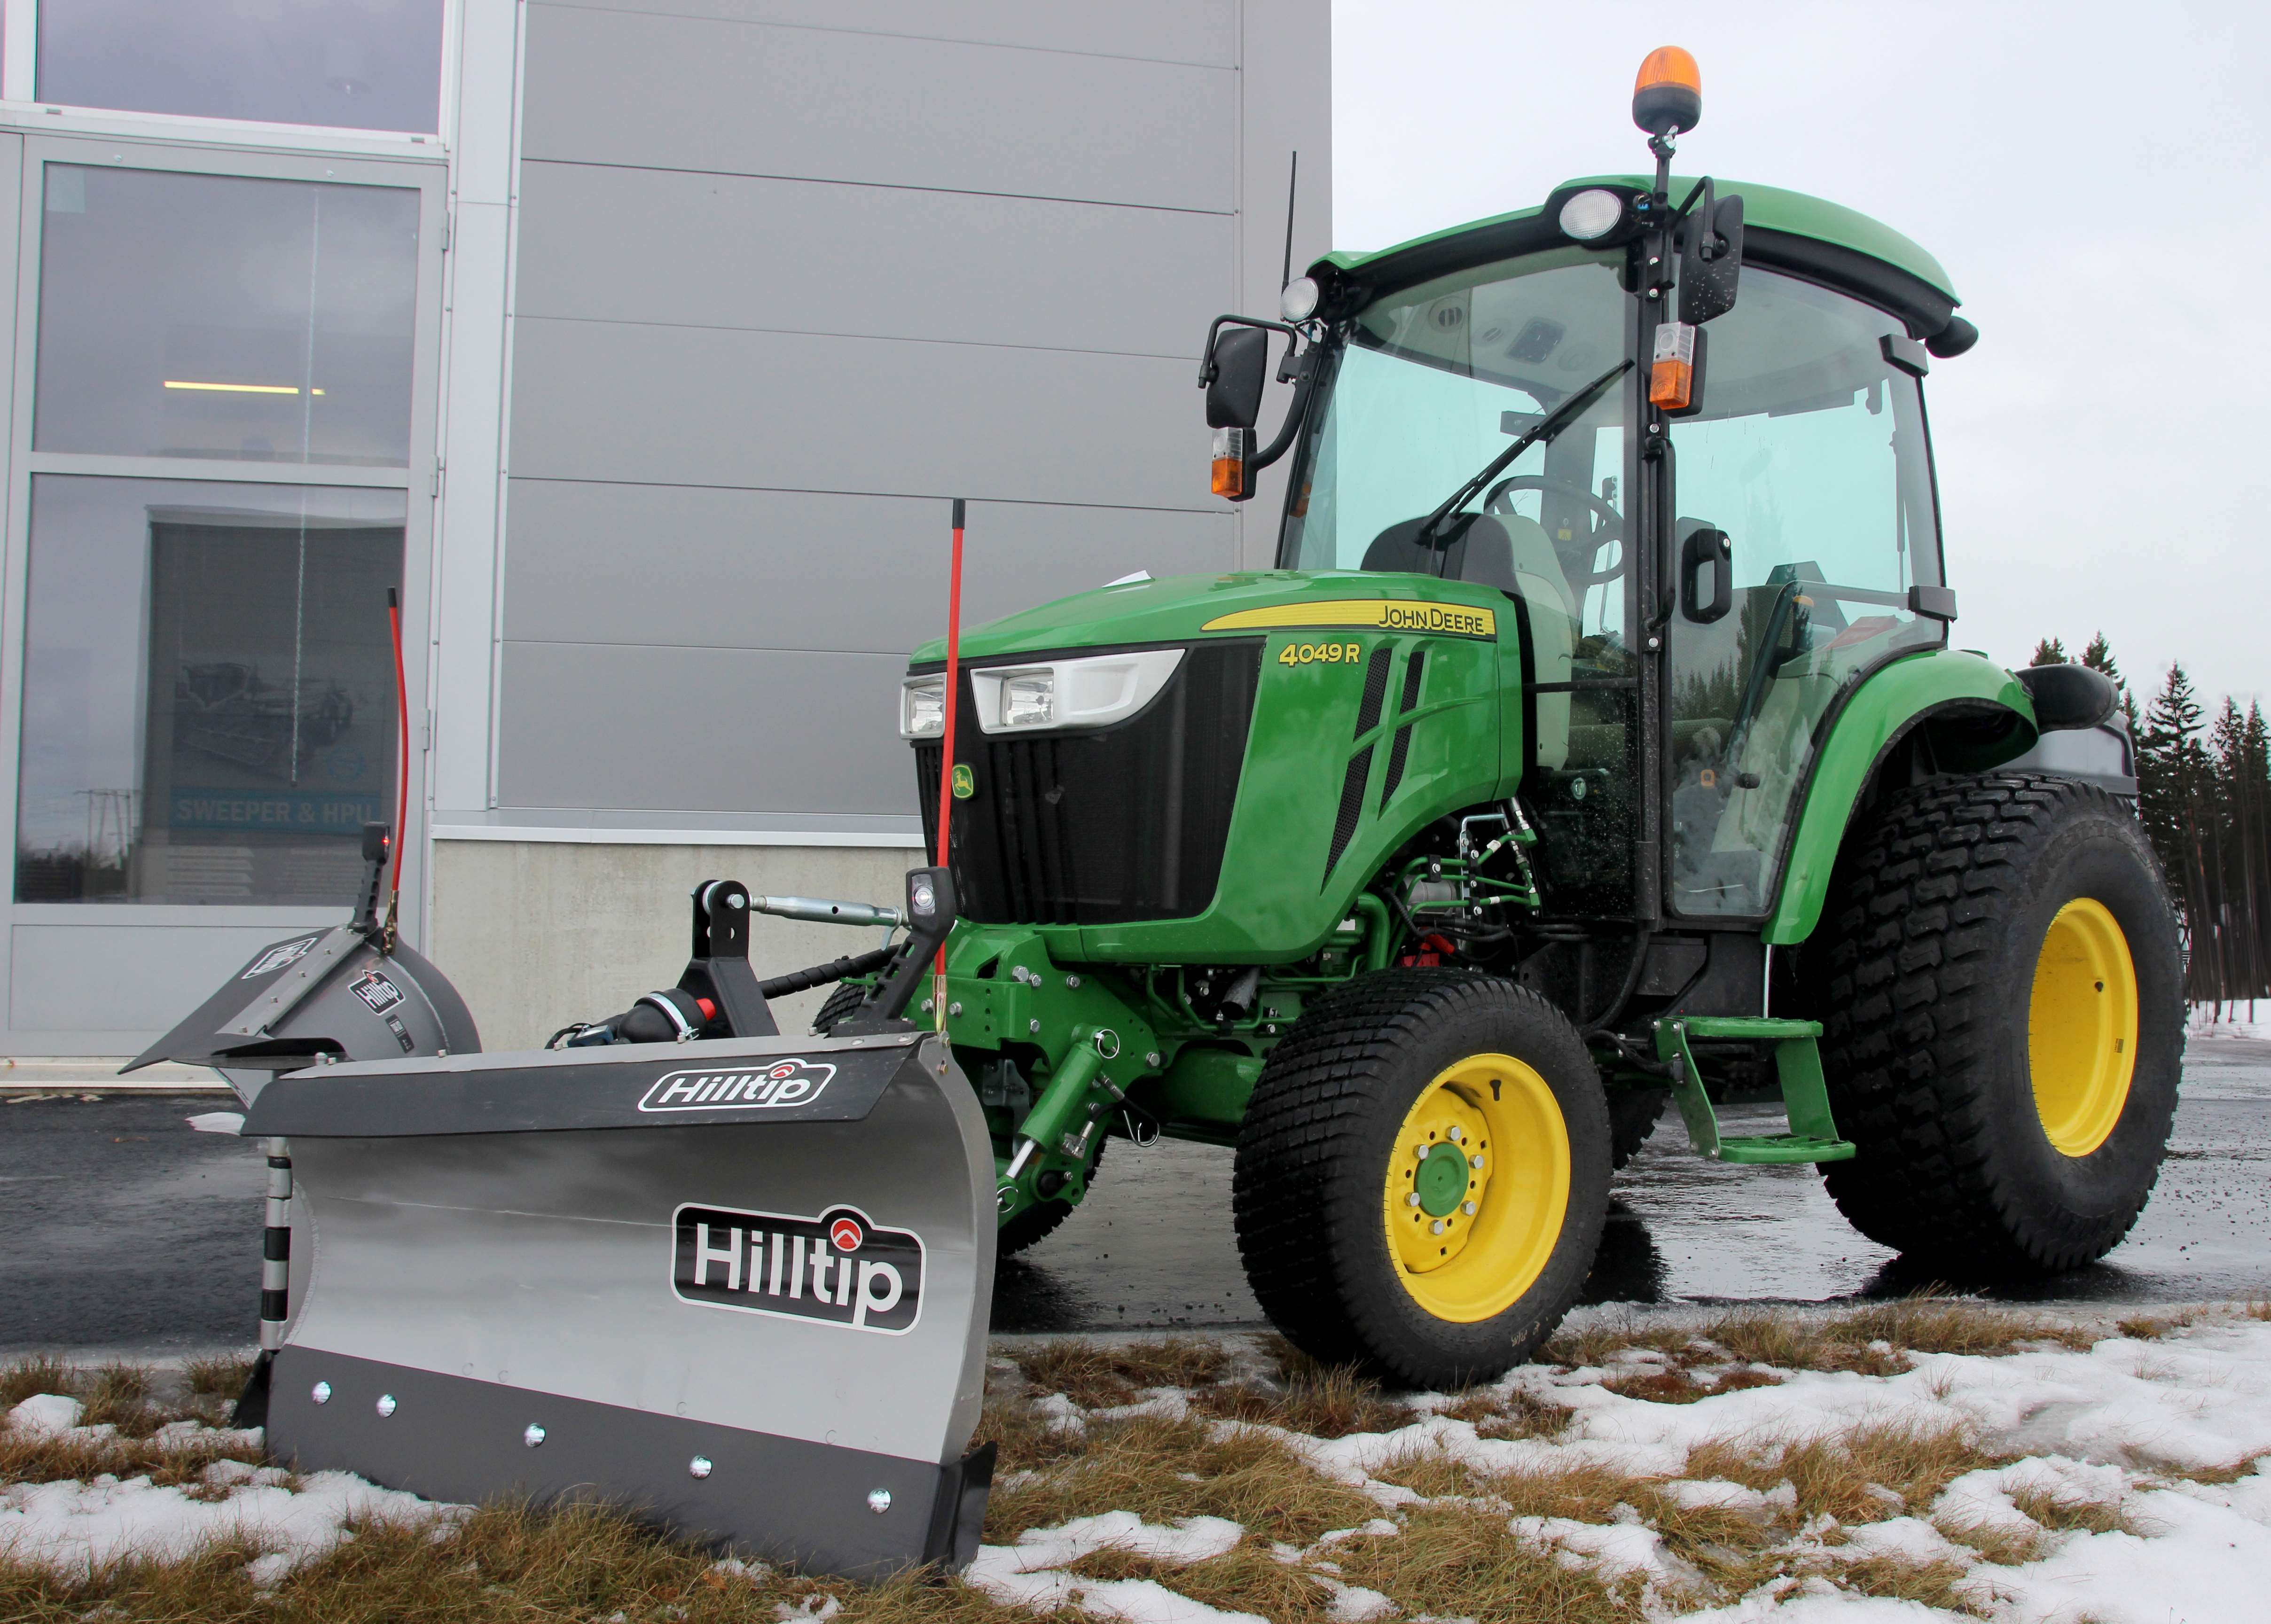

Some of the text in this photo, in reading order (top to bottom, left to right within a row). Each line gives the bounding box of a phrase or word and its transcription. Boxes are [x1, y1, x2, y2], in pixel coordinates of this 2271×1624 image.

[1378, 605, 1484, 632] JOHN DEERE
[177, 799, 372, 823] SWEEPER & HPU
[356, 980, 399, 1009] Hilltip
[658, 1074, 811, 1105] Hilltip
[695, 1223, 903, 1325] Hilltip
